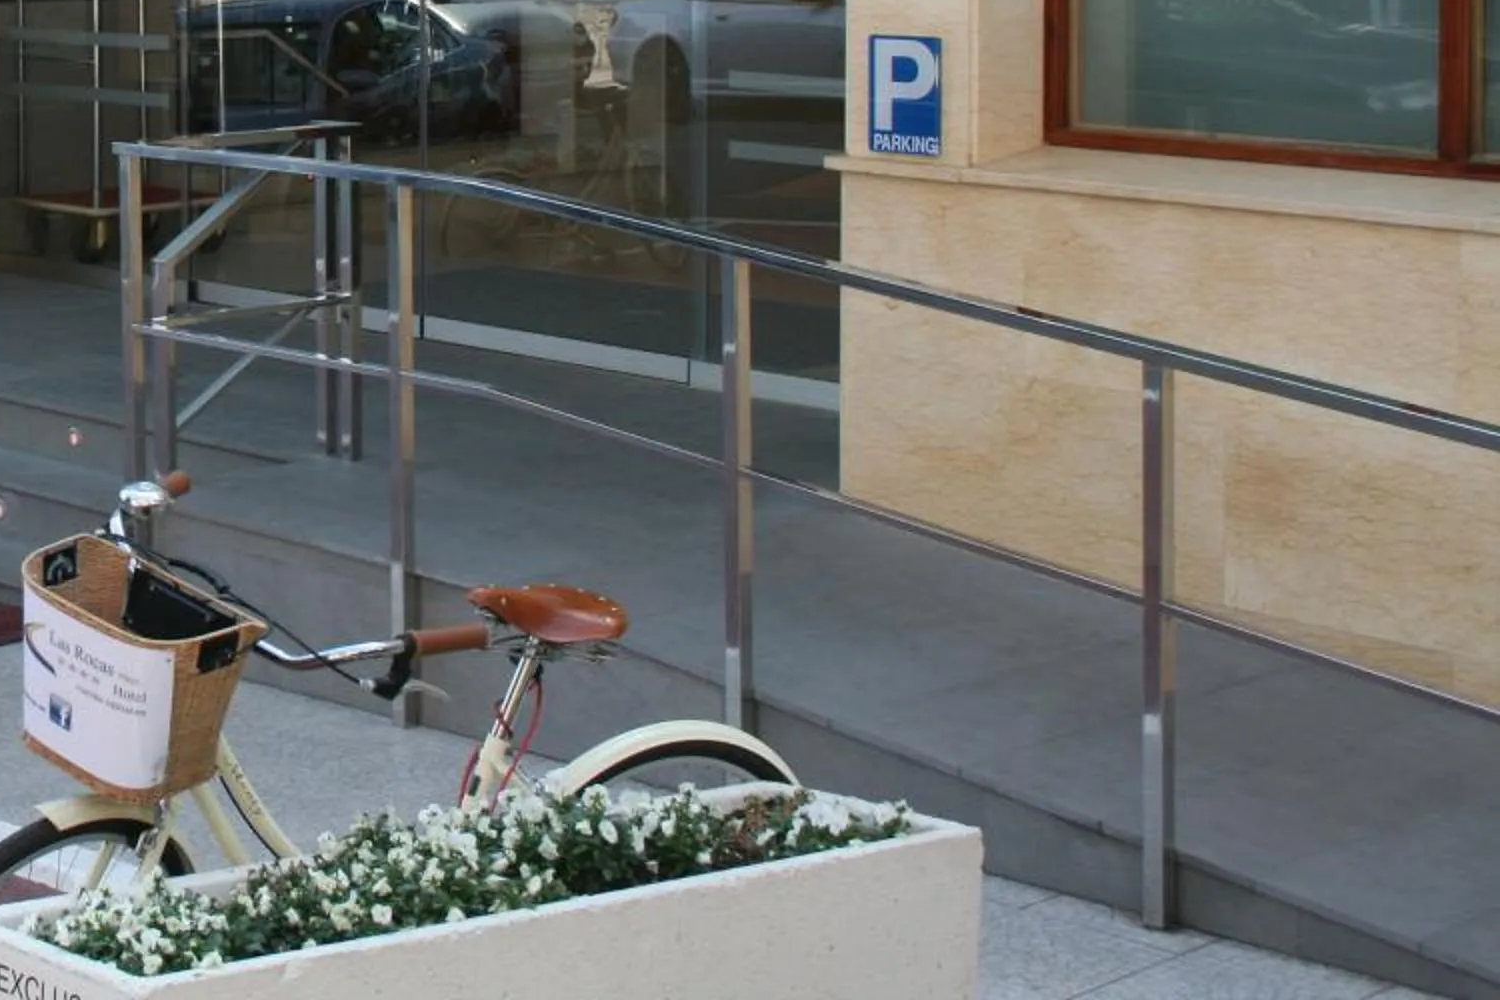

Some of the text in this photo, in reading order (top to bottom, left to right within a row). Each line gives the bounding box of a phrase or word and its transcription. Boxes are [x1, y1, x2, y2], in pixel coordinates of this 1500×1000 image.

[873, 38, 935, 131] P
[873, 133, 939, 154] PARKING
[48, 629, 115, 678] Las Rocas
[112, 683, 148, 703] Hotel
